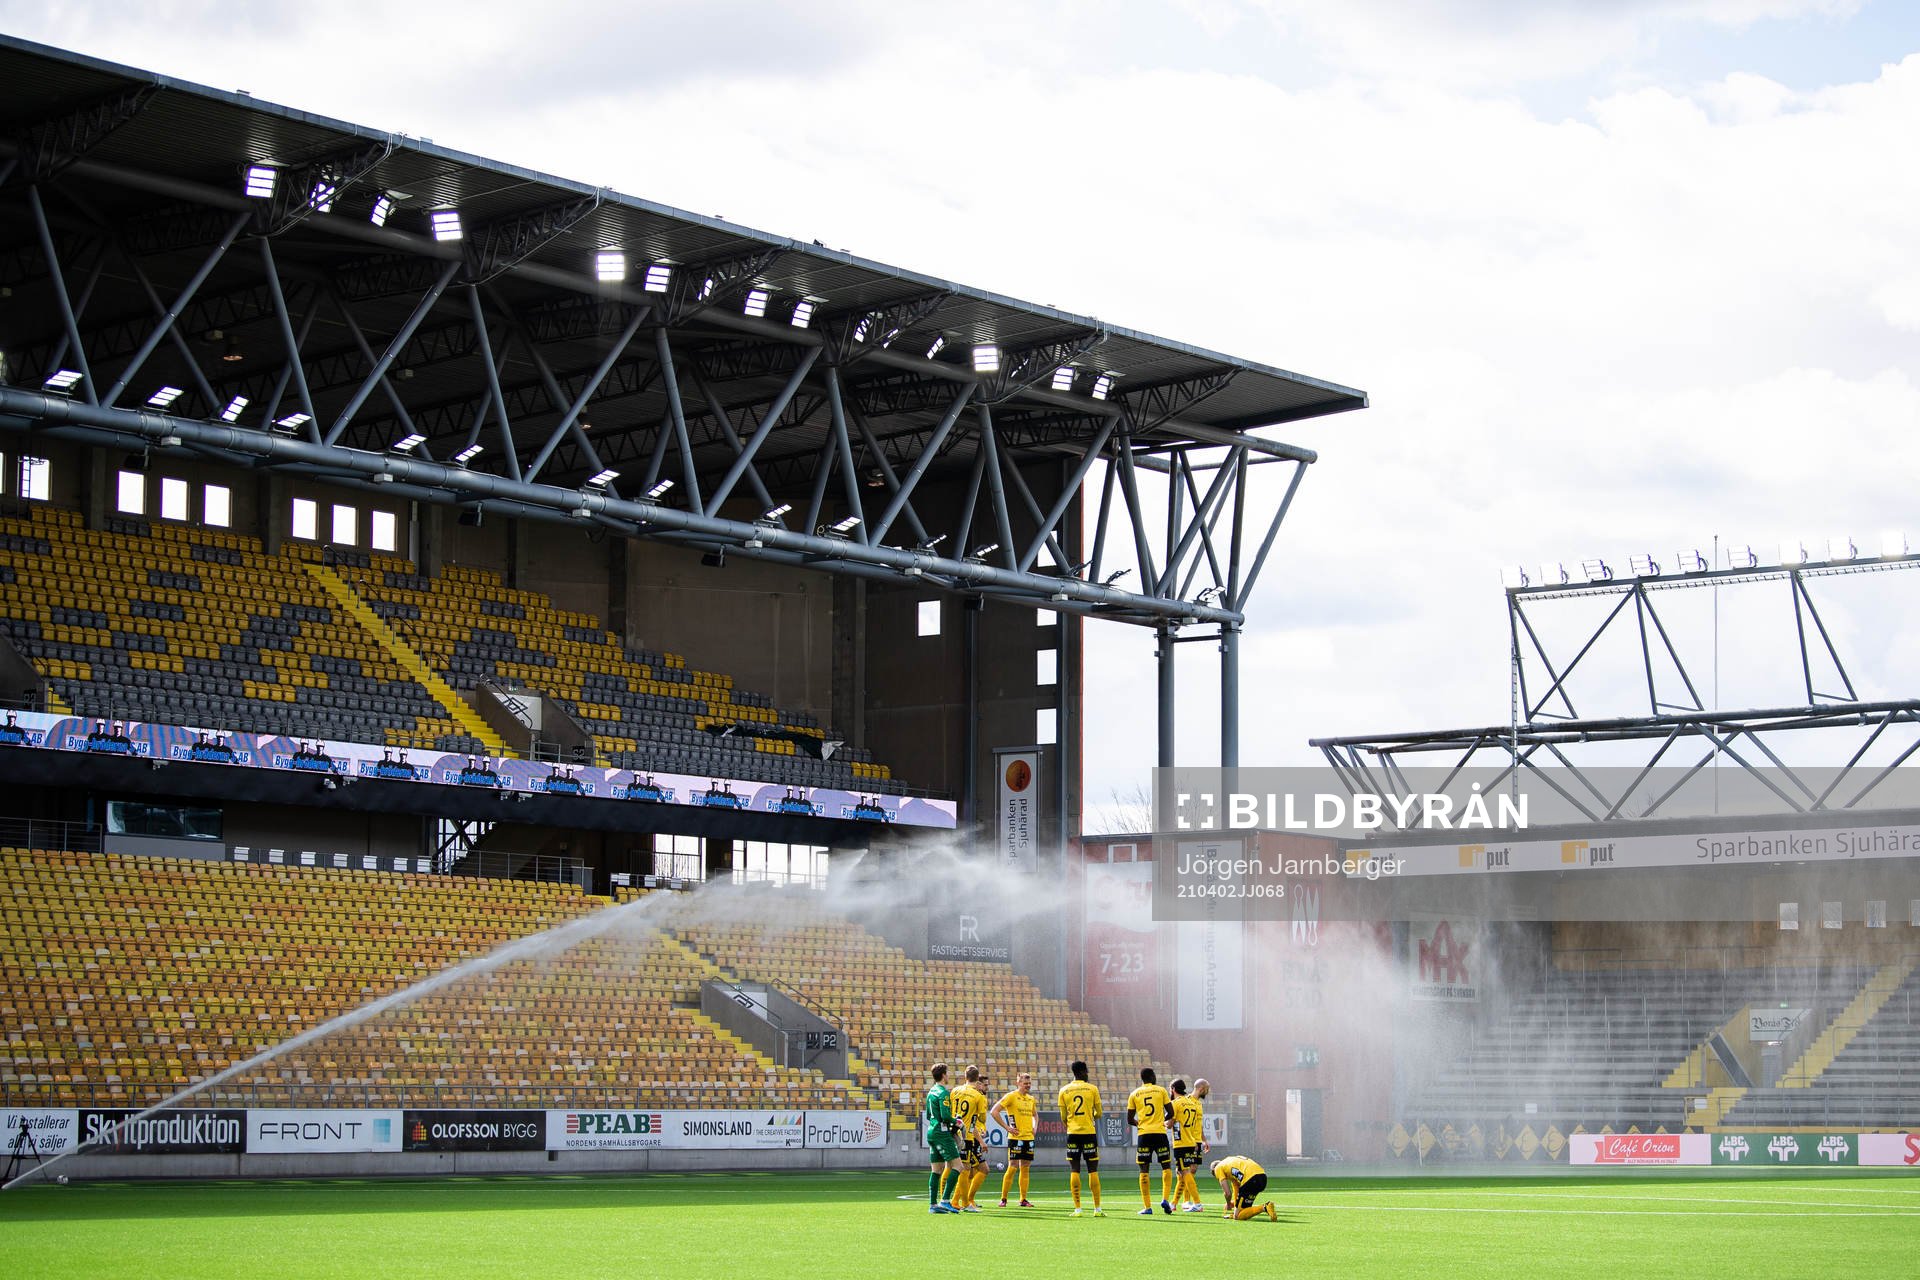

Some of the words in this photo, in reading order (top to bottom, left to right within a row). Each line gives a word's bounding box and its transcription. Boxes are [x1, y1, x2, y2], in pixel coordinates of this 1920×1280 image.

[31, 733, 42, 744] AB
[137, 743, 148, 753] AB
[238, 752, 249, 762] AB
[336, 761, 348, 771] AB
[420, 768, 429, 778] AB
[502, 777, 511, 786] AB
[585, 783, 593, 793] AB
[665, 791, 673, 801] AB
[742, 798, 750, 807] AB
[1019, 798, 1029, 848] Sjuhärad
[1697, 834, 1827, 862] Sparbanken
[931, 945, 1008, 958] FASTIGHETSSERVICE
[1100, 953, 1145, 973] 7-23
[823, 1034, 837, 1046] P2
[955, 1098, 970, 1118] 19
[1073, 1095, 1085, 1116] 2
[1143, 1097, 1155, 1117] 5
[7, 1115, 17, 1129] Vi
[577, 1114, 651, 1134] PEAB
[1107, 1118, 1122, 1127] DEMI
[1183, 1108, 1197, 1128] 27
[259, 1122, 362, 1140] FRONT
[432, 1123, 499, 1138] OLOFSSON
[503, 1123, 538, 1138] BYGG
[683, 1121, 752, 1136] SIMONSLAND
[809, 1125, 863, 1144] ProFlow
[1107, 1127, 1122, 1136] DEKK
[39, 1135, 67, 1152] säljer
[566, 1139, 597, 1147] NORDENS
[1724, 1136, 1745, 1146] LBC
[1773, 1136, 1794, 1146] LBC
[1823, 1136, 1844, 1146] LBC
[1609, 1138, 1639, 1157] Café
[1642, 1139, 1674, 1152] Orion
